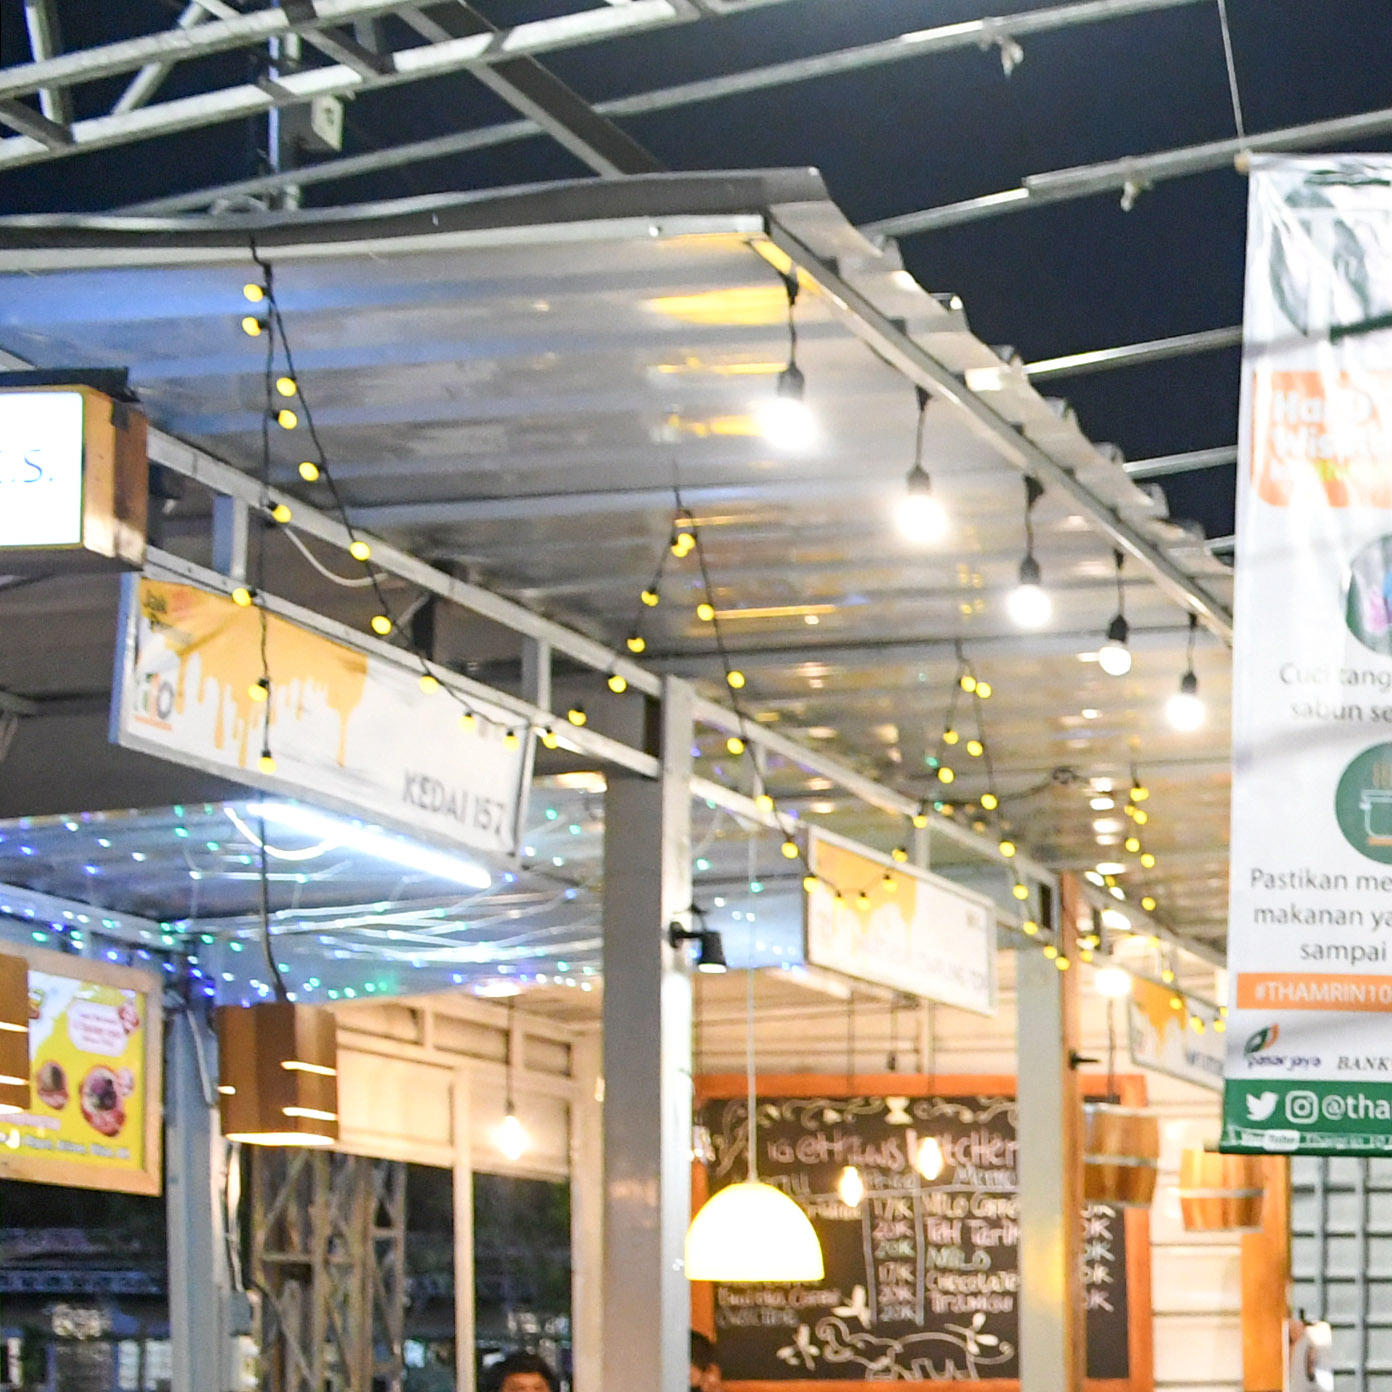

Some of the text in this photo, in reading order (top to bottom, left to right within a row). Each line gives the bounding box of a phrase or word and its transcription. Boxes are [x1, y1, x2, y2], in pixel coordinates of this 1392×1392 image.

[1289, 698, 1363, 722] sabun
[402, 767, 469, 825] KEDAI
[1250, 868, 1348, 891] Pastikan
[1254, 904, 1363, 927] makanan
[1300, 942, 1387, 965] sampai
[1249, 1055, 1322, 1071] pasar jaya
[1337, 1056, 1390, 1072] BANK
